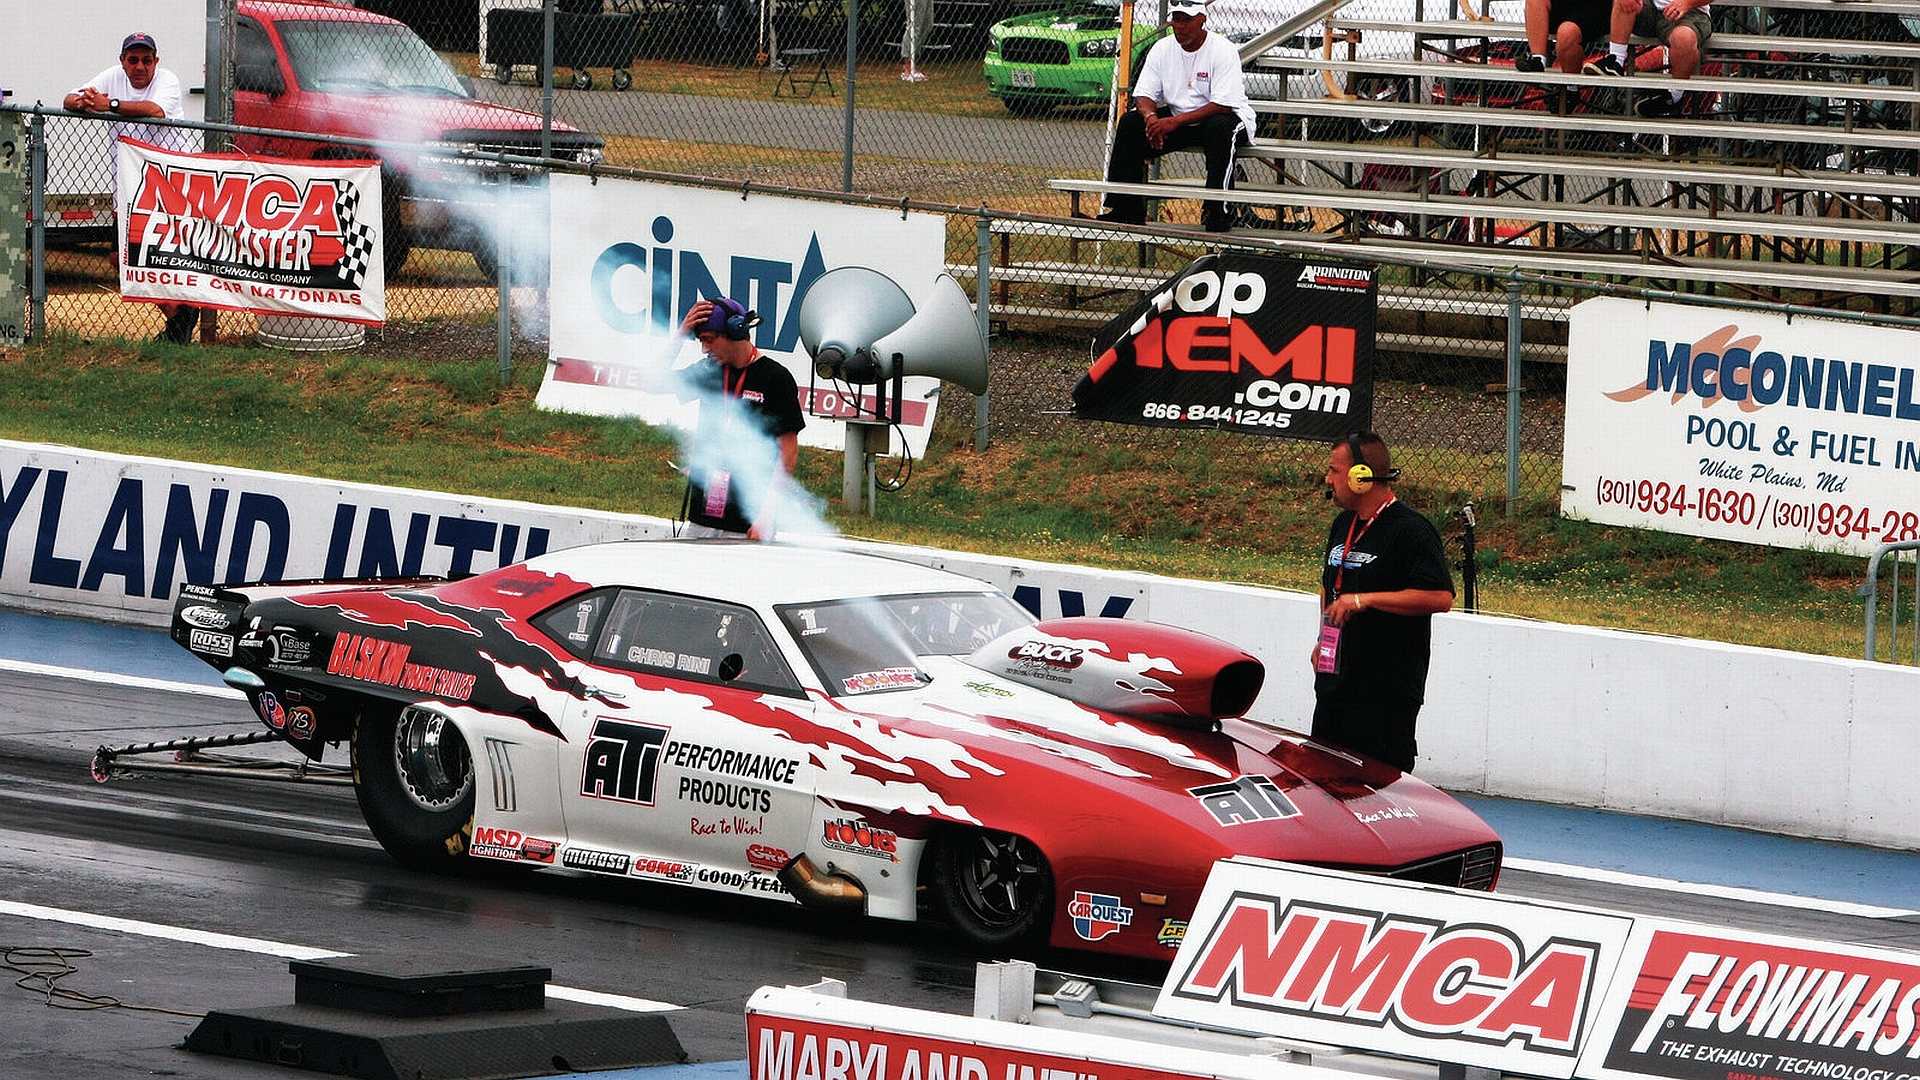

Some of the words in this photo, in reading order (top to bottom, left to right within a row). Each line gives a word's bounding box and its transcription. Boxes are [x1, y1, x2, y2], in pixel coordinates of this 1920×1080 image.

[137, 163, 340, 233] NMCA
[137, 212, 313, 271] FLOWMASTER
[150, 254, 169, 266] THE
[169, 256, 210, 271] EXHAUST
[211, 264, 269, 281] TECHNOLOGY
[270, 273, 312, 285] COMPANY
[1297, 265, 1372, 283] ARRINGTON
[126, 269, 198, 287] MUSCLE
[210, 279, 243, 295] CAR
[250, 286, 362, 306] NATIONALS
[592, 365, 640, 387] THE
[1234, 380, 1351, 415] .com
[1687, 415, 1761, 452] POOL
[1773, 425, 1799, 457] &
[1810, 430, 1881, 467] FUEL
[1699, 458, 1744, 483] White
[1816, 471, 1848, 493] Md
[184, 584, 216, 597] PENSKE
[192, 631, 230, 649] ROSS
[1017, 640, 1082, 663] BUCK
[627, 646, 675, 668] CHRIS
[677, 654, 711, 675] RINI
[582, 717, 670, 804] ATI
[663, 740, 800, 785] PERFORMANCE
[678, 777, 772, 814] PRODUCTS
[690, 817, 717, 836] Race
[720, 817, 732, 834] to
[733, 816, 764, 836] Win!
[1354, 810, 1380, 824] Race
[1379, 809, 1392, 821] to
[473, 845, 517, 859] IGNITION
[474, 826, 523, 848] MSD
[635, 858, 682, 875] COMP
[1069, 902, 1132, 924] CARQUEST
[1185, 898, 1594, 1048] NMCA
[1658, 1040, 1691, 1060] THE
[1693, 1046, 1773, 1070] EXHAUST
[1775, 1056, 1895, 1080] TECHNOLOGY
